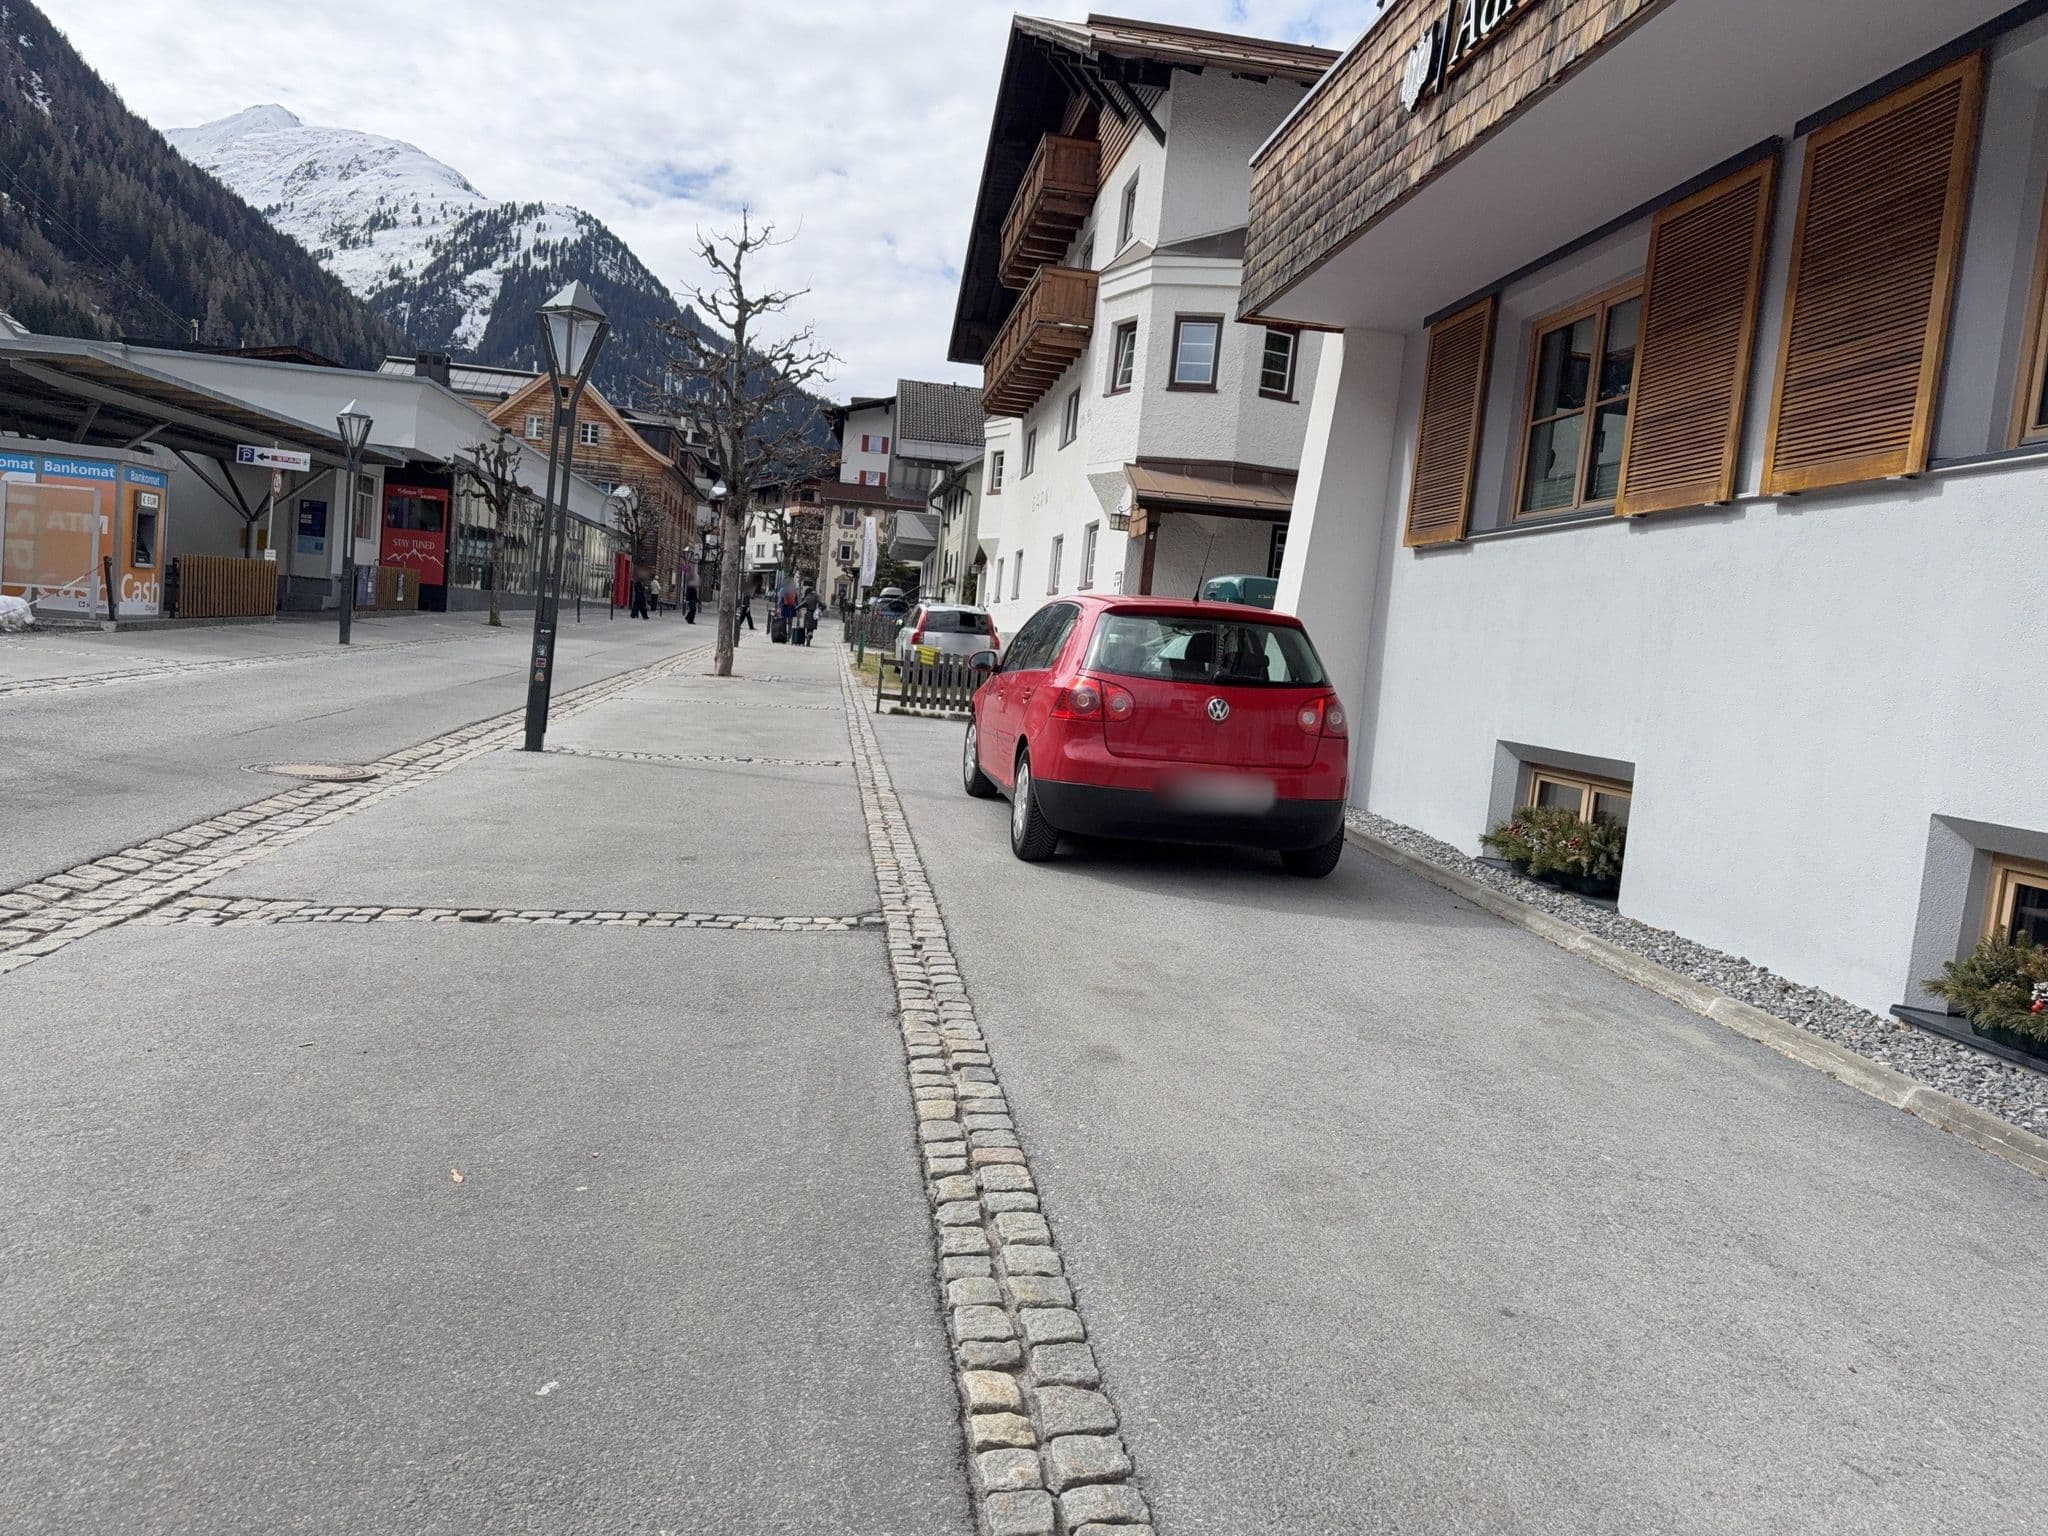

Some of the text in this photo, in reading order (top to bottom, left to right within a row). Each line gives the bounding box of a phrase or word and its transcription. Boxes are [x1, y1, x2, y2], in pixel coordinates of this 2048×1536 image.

[44, 461, 115, 479] Bankomat
[130, 470, 160, 486] Bankomat
[147, 496, 157, 506] EUR
[392, 538, 436, 550] STAY TUNED
[120, 573, 160, 602] Cash
